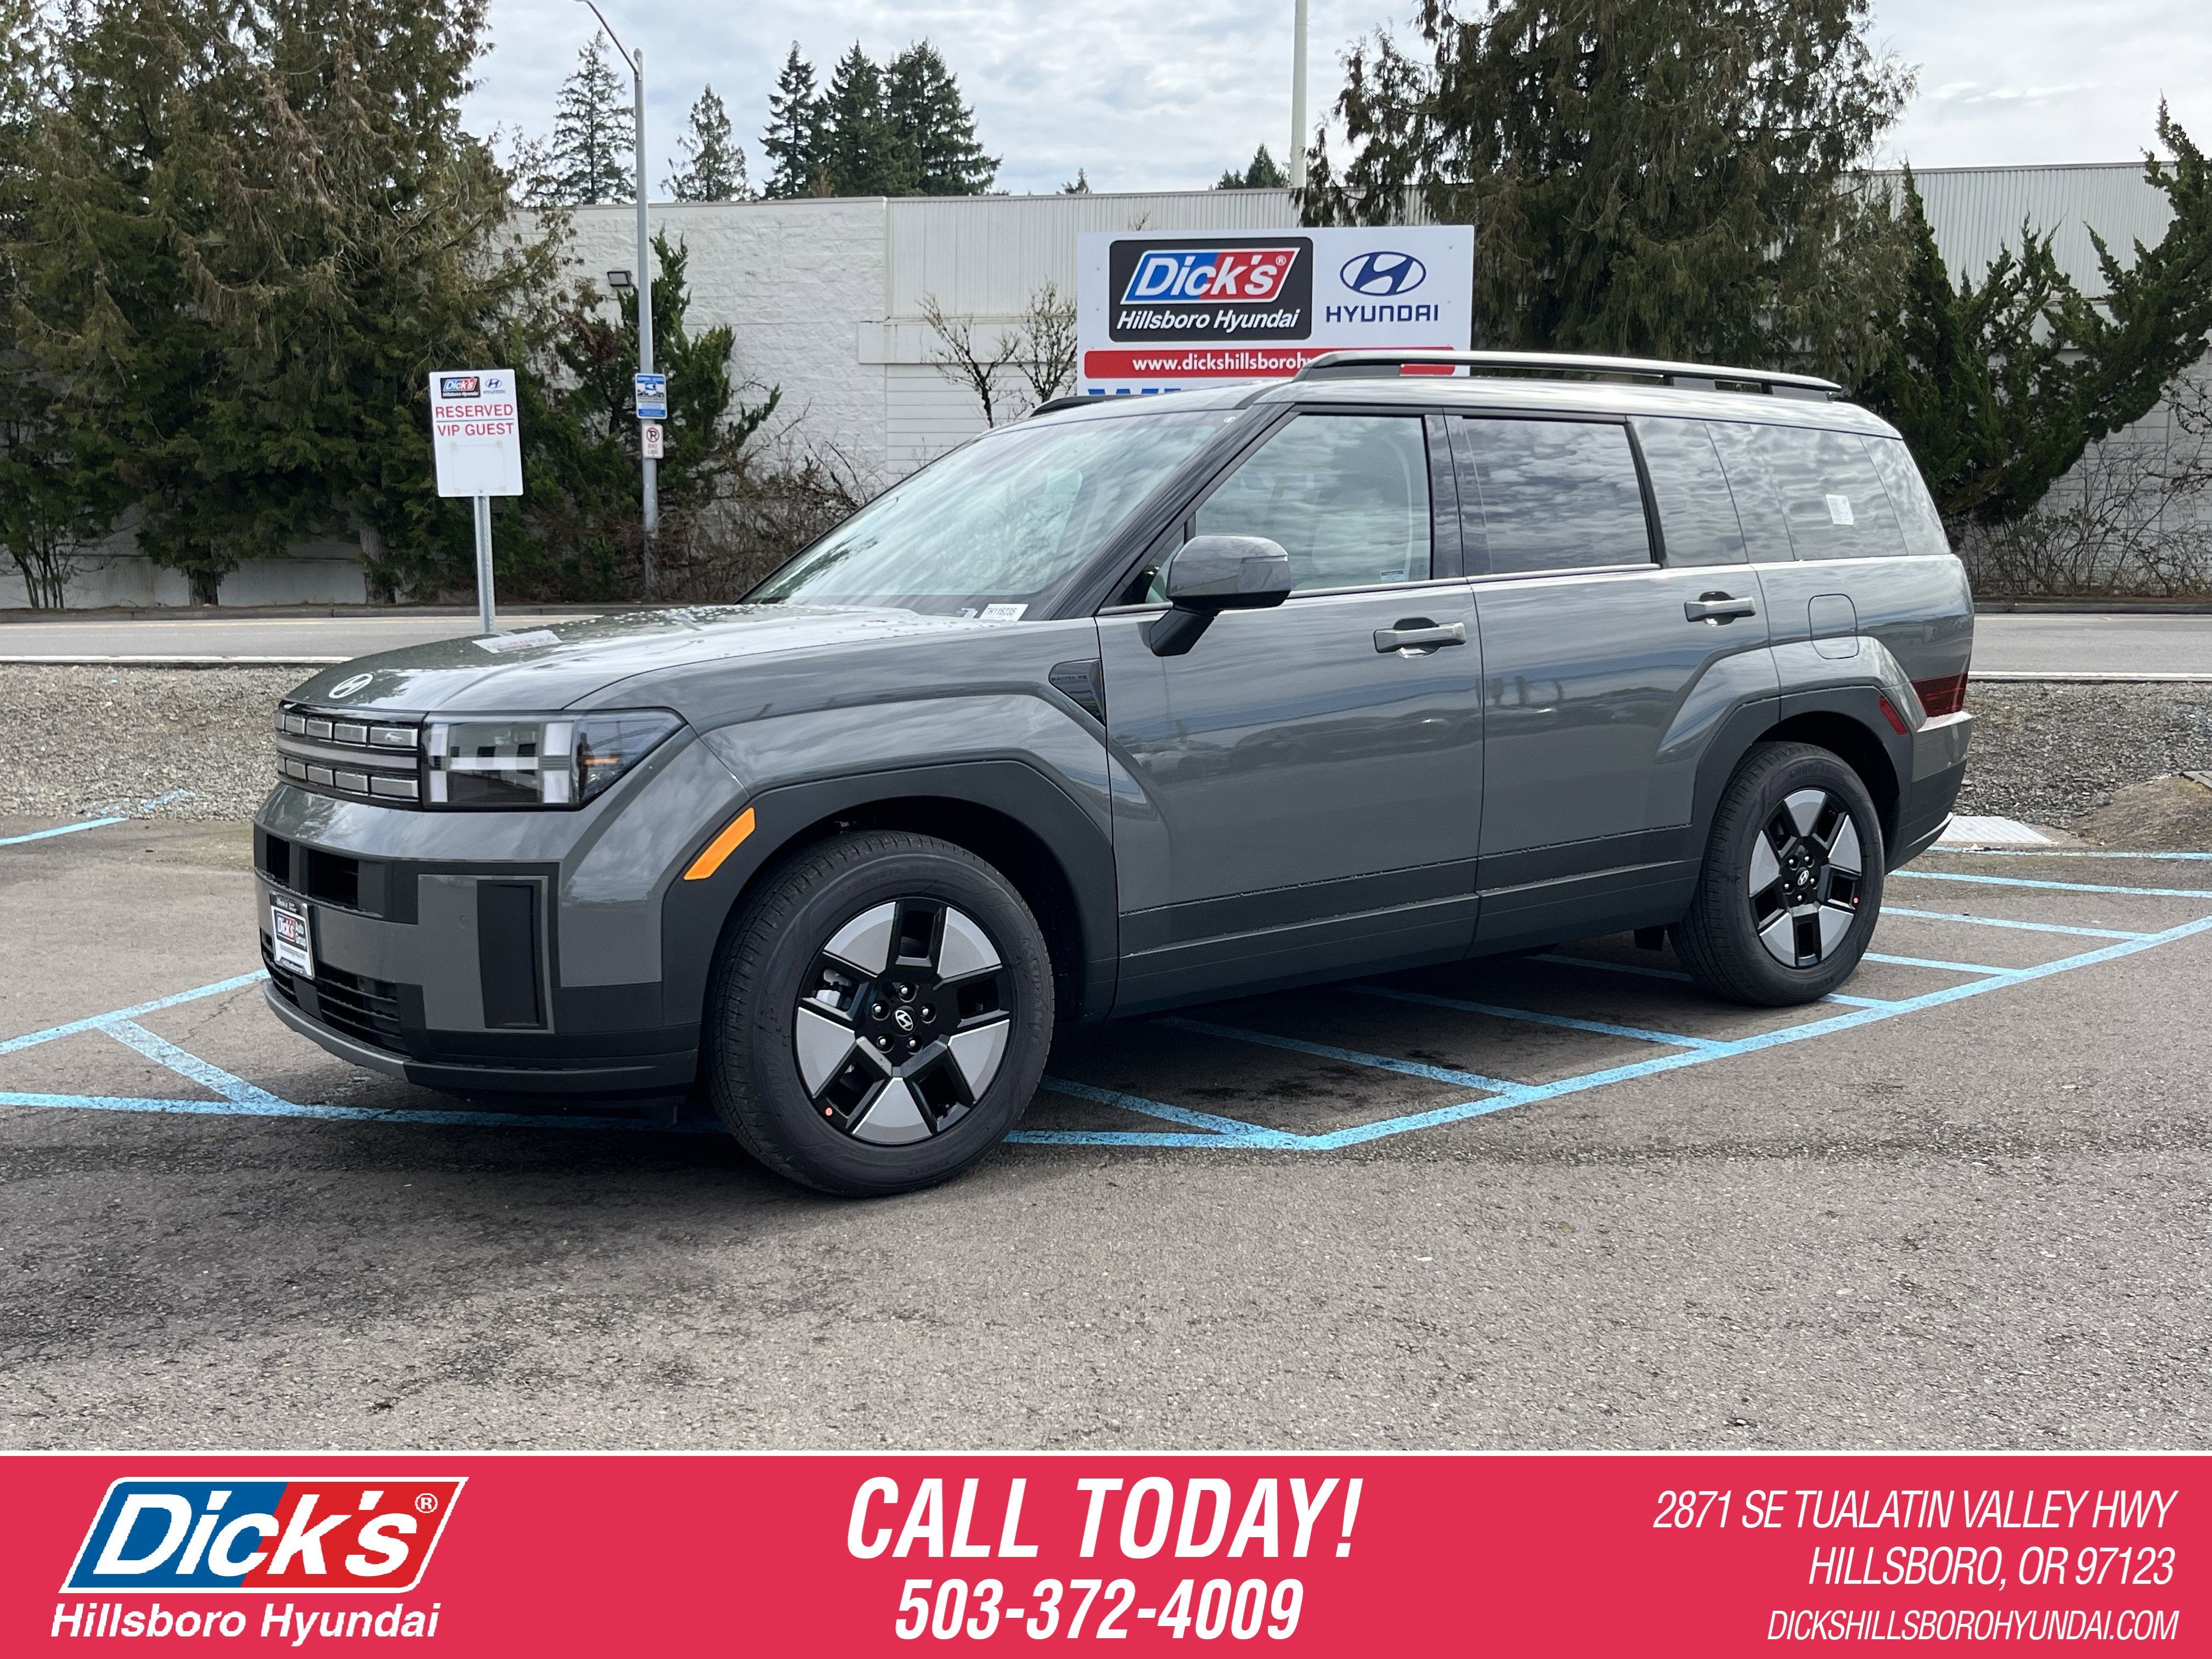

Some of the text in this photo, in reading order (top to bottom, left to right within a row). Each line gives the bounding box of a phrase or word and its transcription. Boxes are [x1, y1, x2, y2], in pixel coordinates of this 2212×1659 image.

[1134, 255, 1278, 297] Dick's
[1116, 308, 1301, 334] Hillsboro Hyundai
[1325, 304, 1439, 323] HYUNDAI
[445, 379, 474, 390] Dick's
[435, 403, 514, 418] RESERVED
[437, 422, 514, 437] VIP GUEST
